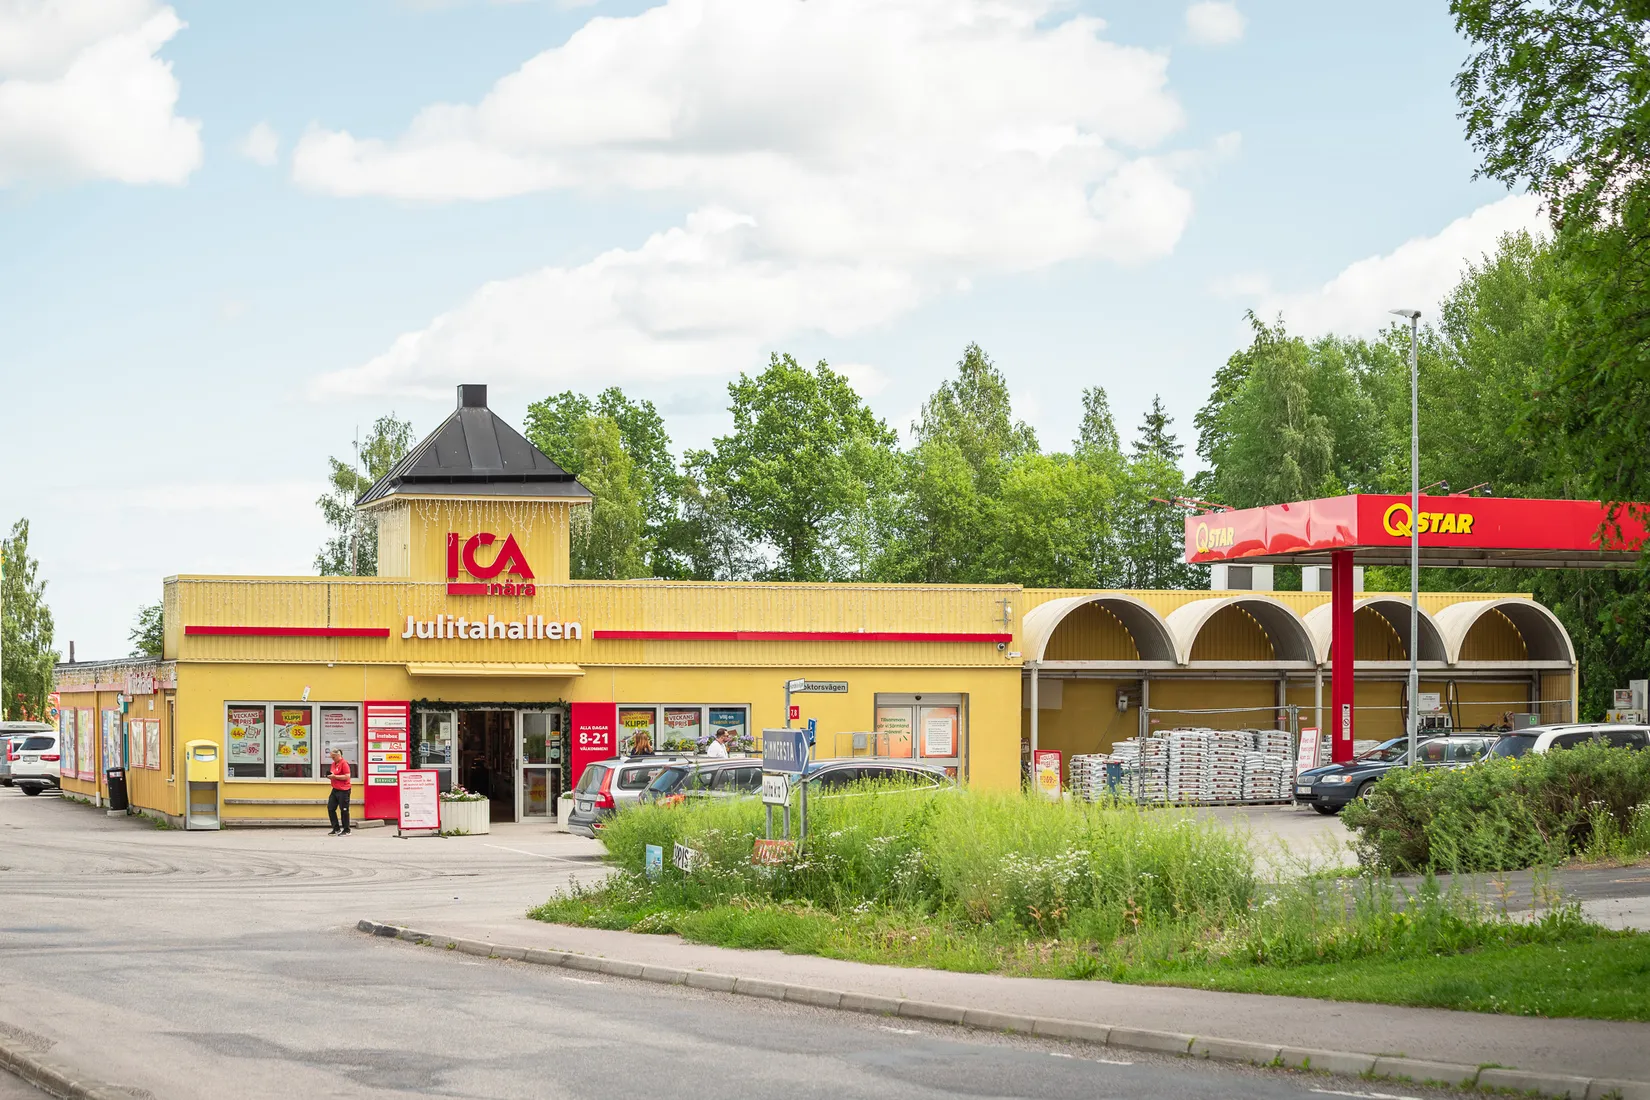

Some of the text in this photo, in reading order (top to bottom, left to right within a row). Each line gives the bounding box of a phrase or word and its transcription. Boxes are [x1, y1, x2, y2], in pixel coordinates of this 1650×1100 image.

[447, 532, 535, 579] ICA
[490, 579, 536, 596] nära
[401, 614, 582, 640] Julitahallen
[804, 683, 846, 691] oktorsvägen
[625, 720, 648, 728] KLIPP!
[579, 732, 609, 745] 8-21
